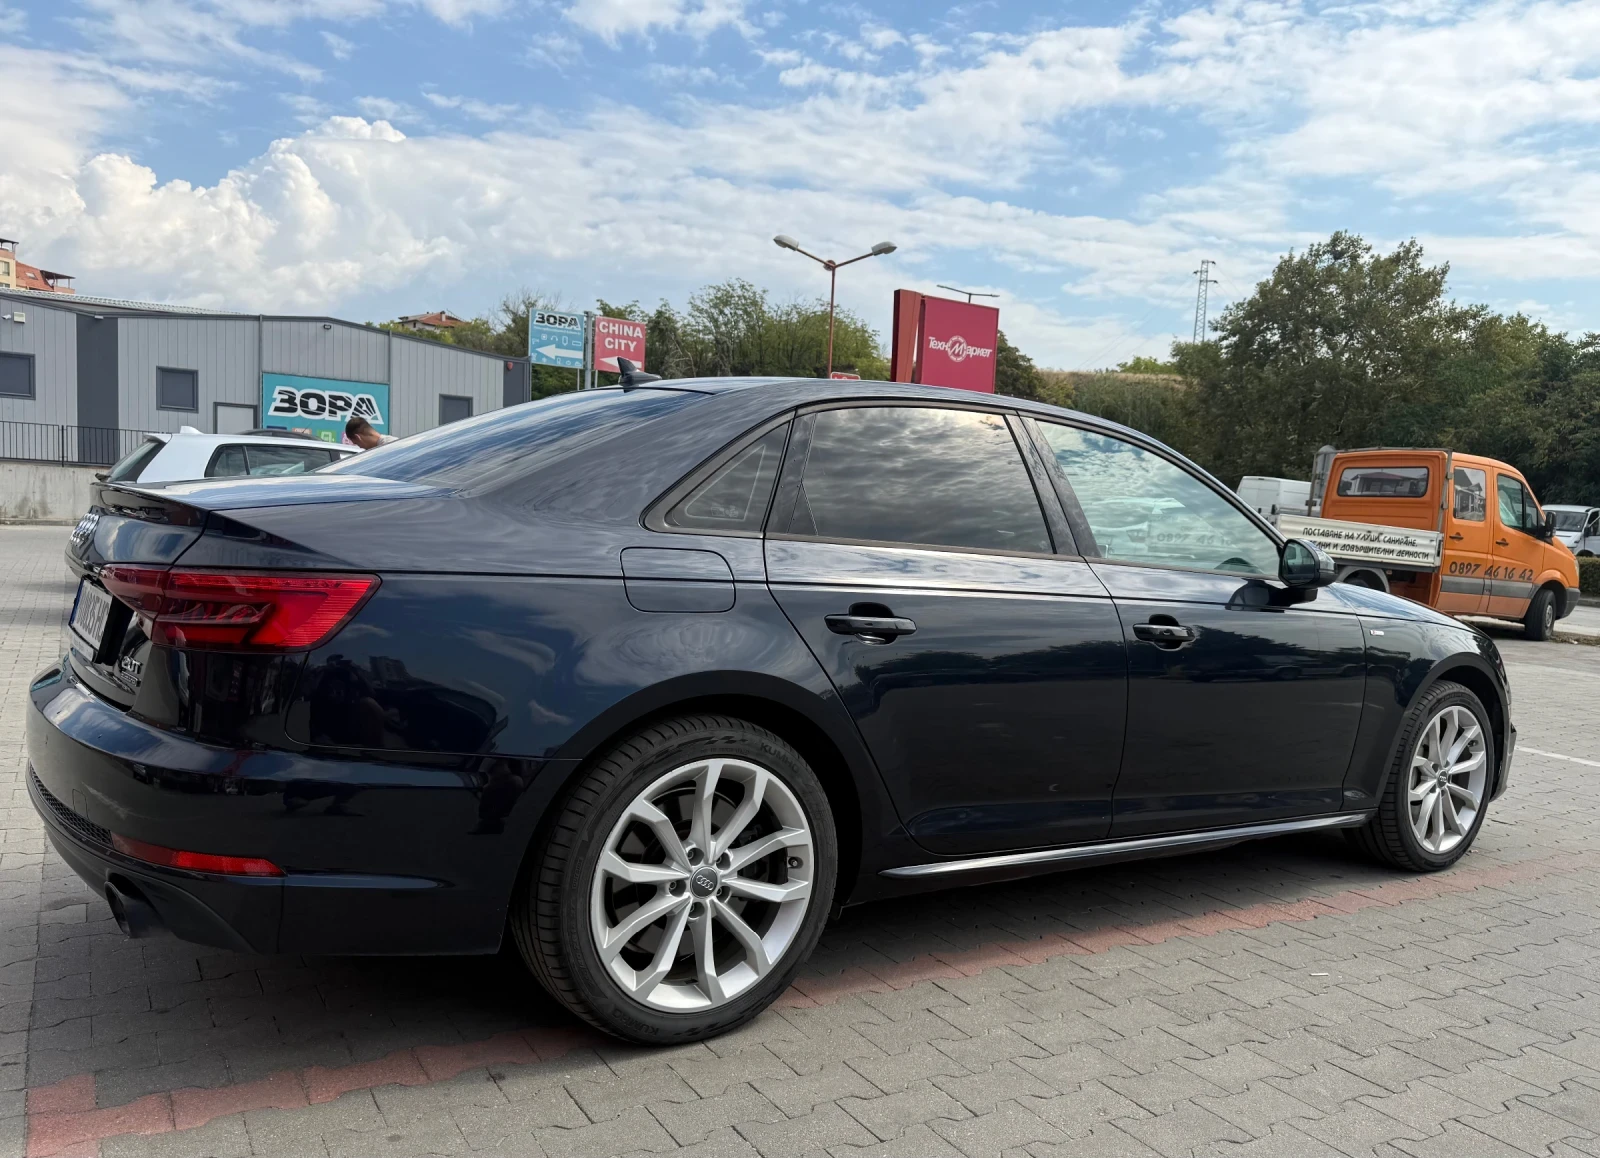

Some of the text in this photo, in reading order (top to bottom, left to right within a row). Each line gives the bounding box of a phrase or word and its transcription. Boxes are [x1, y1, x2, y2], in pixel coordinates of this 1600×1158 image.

[534, 312, 581, 330] ЗОРА
[599, 321, 643, 339] CHINA
[604, 337, 637, 352] CITY
[270, 387, 381, 422] ЗОРА
[1302, 527, 1343, 539] ПОСТАВЯНЕ
[1344, 531, 1355, 540] НА
[1332, 542, 1339, 551] И
[1340, 543, 1395, 557] ДОВЪРШИТЕЛНИ
[1449, 561, 1534, 581] 0897 46 16 42
[759, 742, 800, 774] KUMHO
